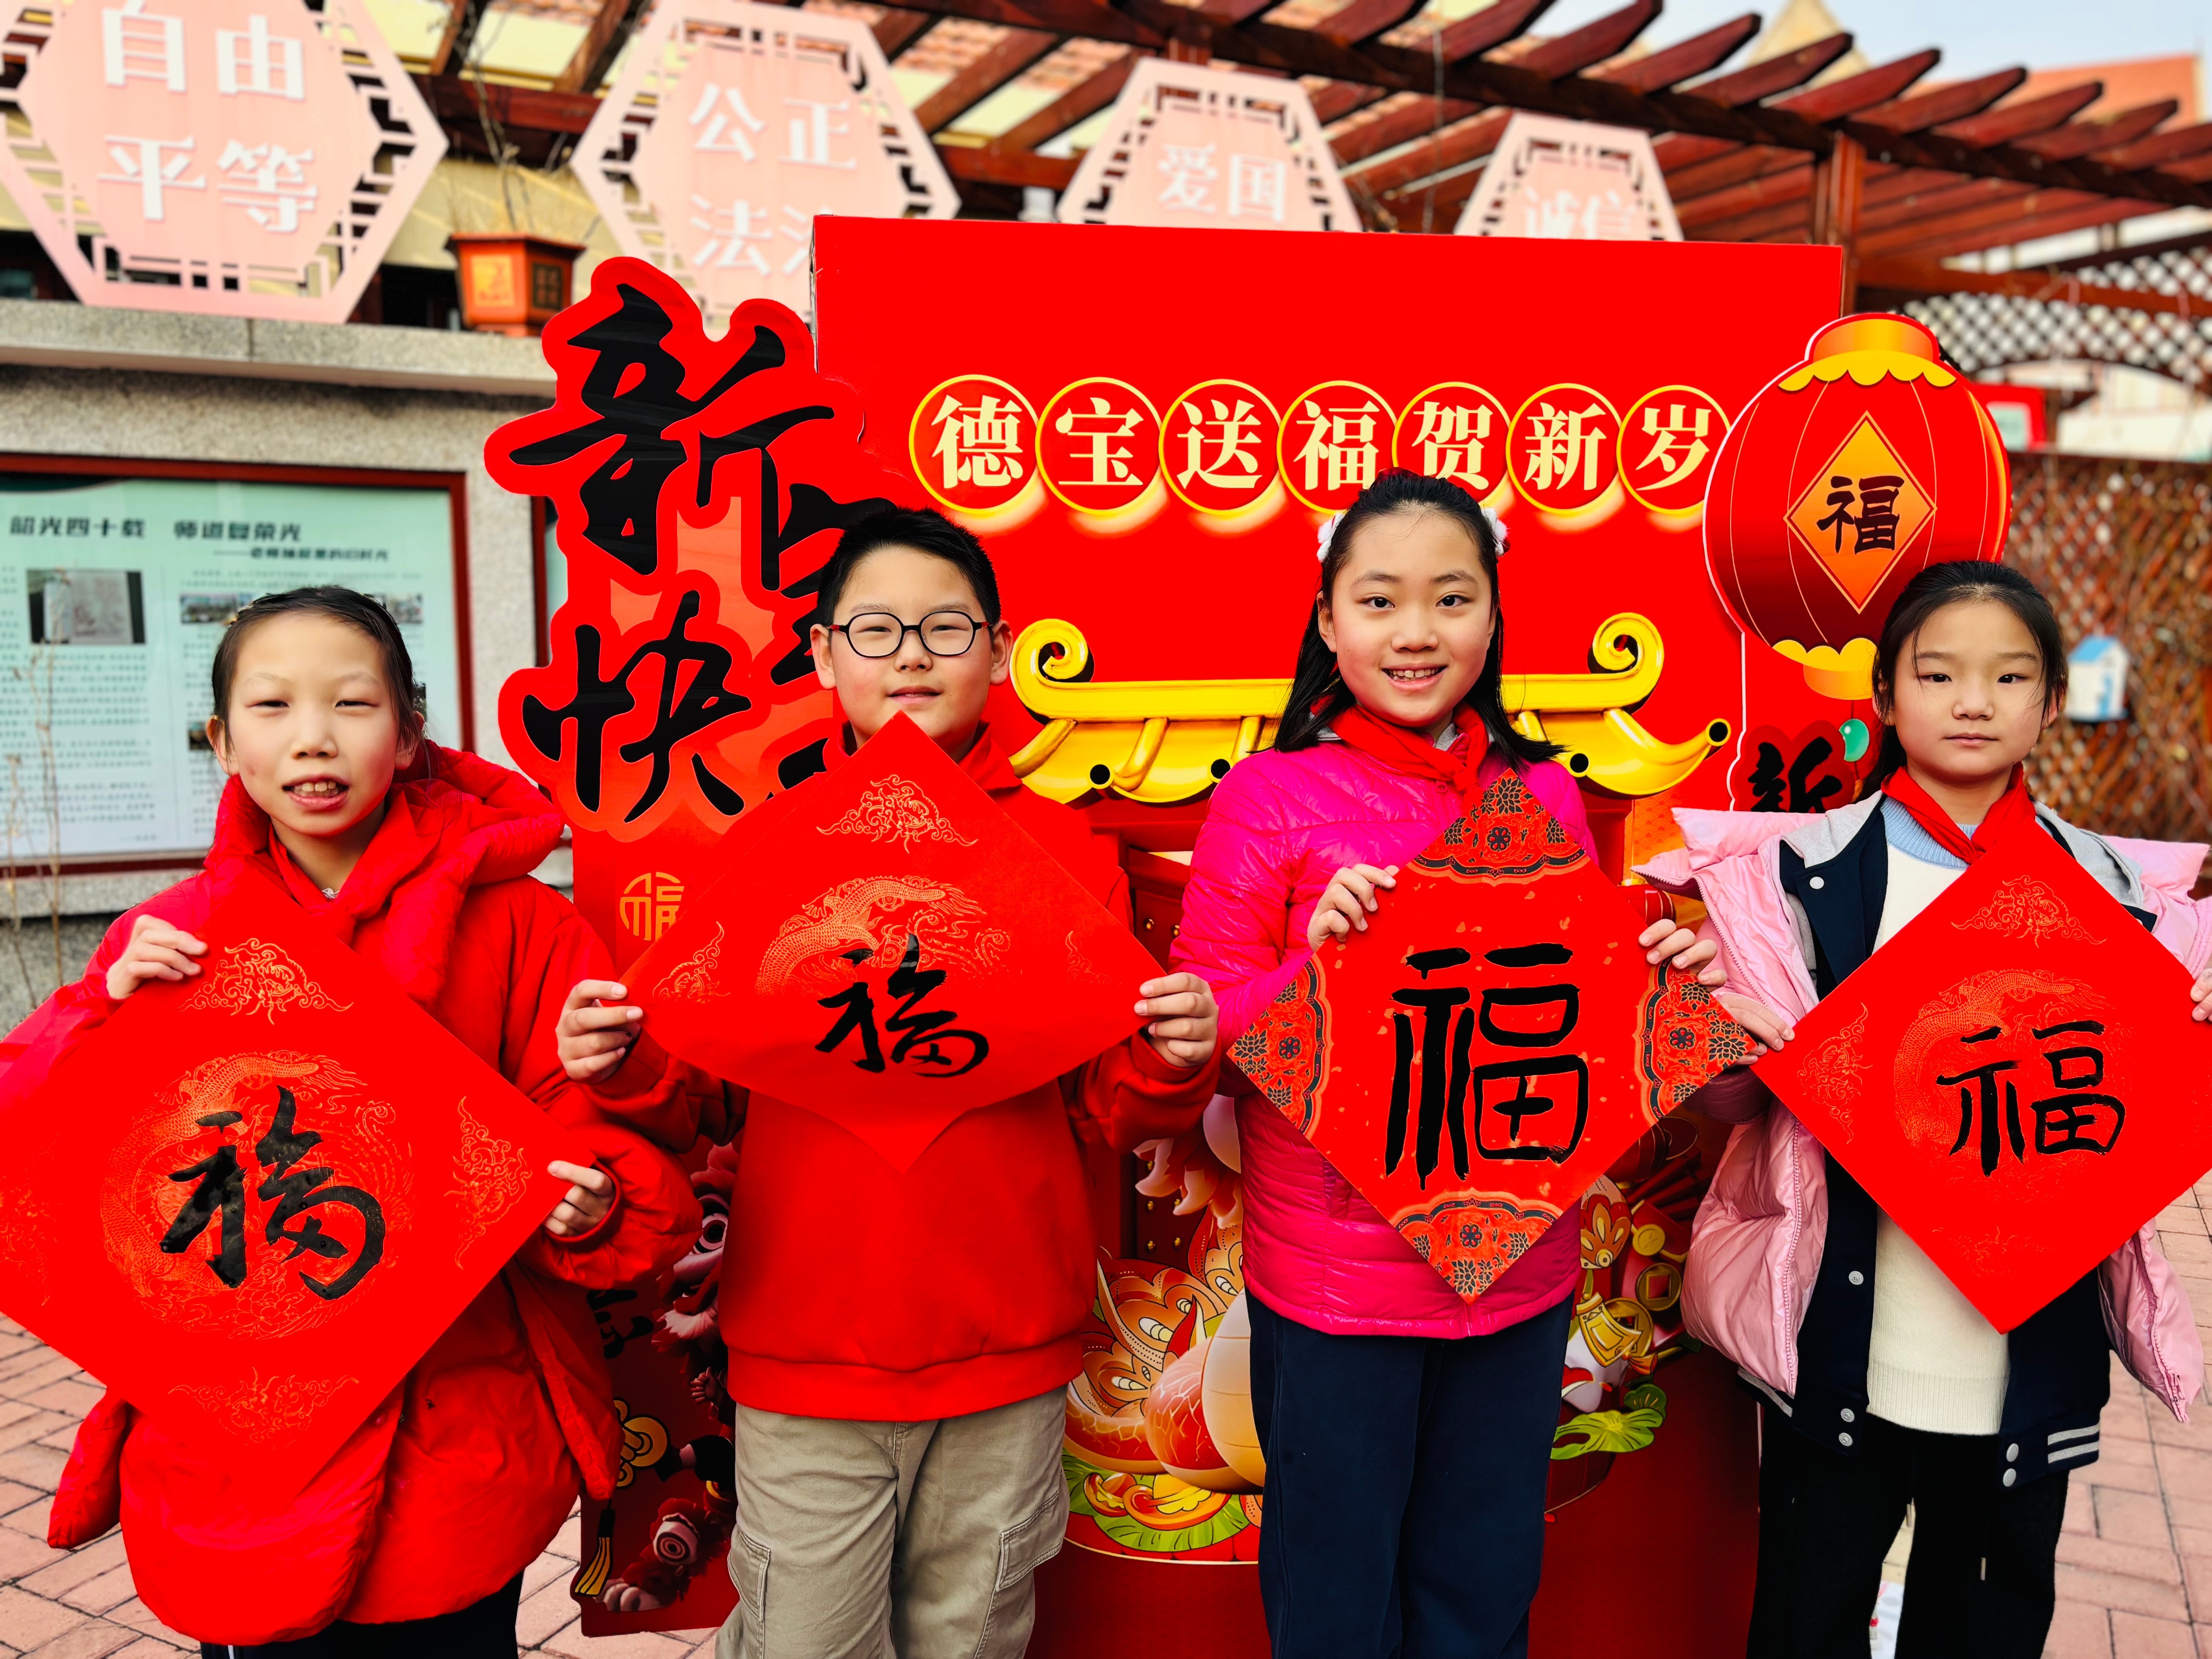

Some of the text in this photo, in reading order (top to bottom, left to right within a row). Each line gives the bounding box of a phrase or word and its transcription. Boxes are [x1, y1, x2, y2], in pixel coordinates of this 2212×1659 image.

[102, 0, 306, 101] 自由
[688, 82, 857, 170] 公正
[97, 134, 318, 232] 平等
[1158, 143, 1286, 223] 爱国
[931, 394, 1712, 492] 德宝送福贺新岁
[1816, 475, 1905, 554] 福
[815, 933, 989, 1079] 福
[1385, 943, 1589, 1191] 福
[1936, 1020, 2126, 1177] 福
[160, 1085, 386, 1300] 福
